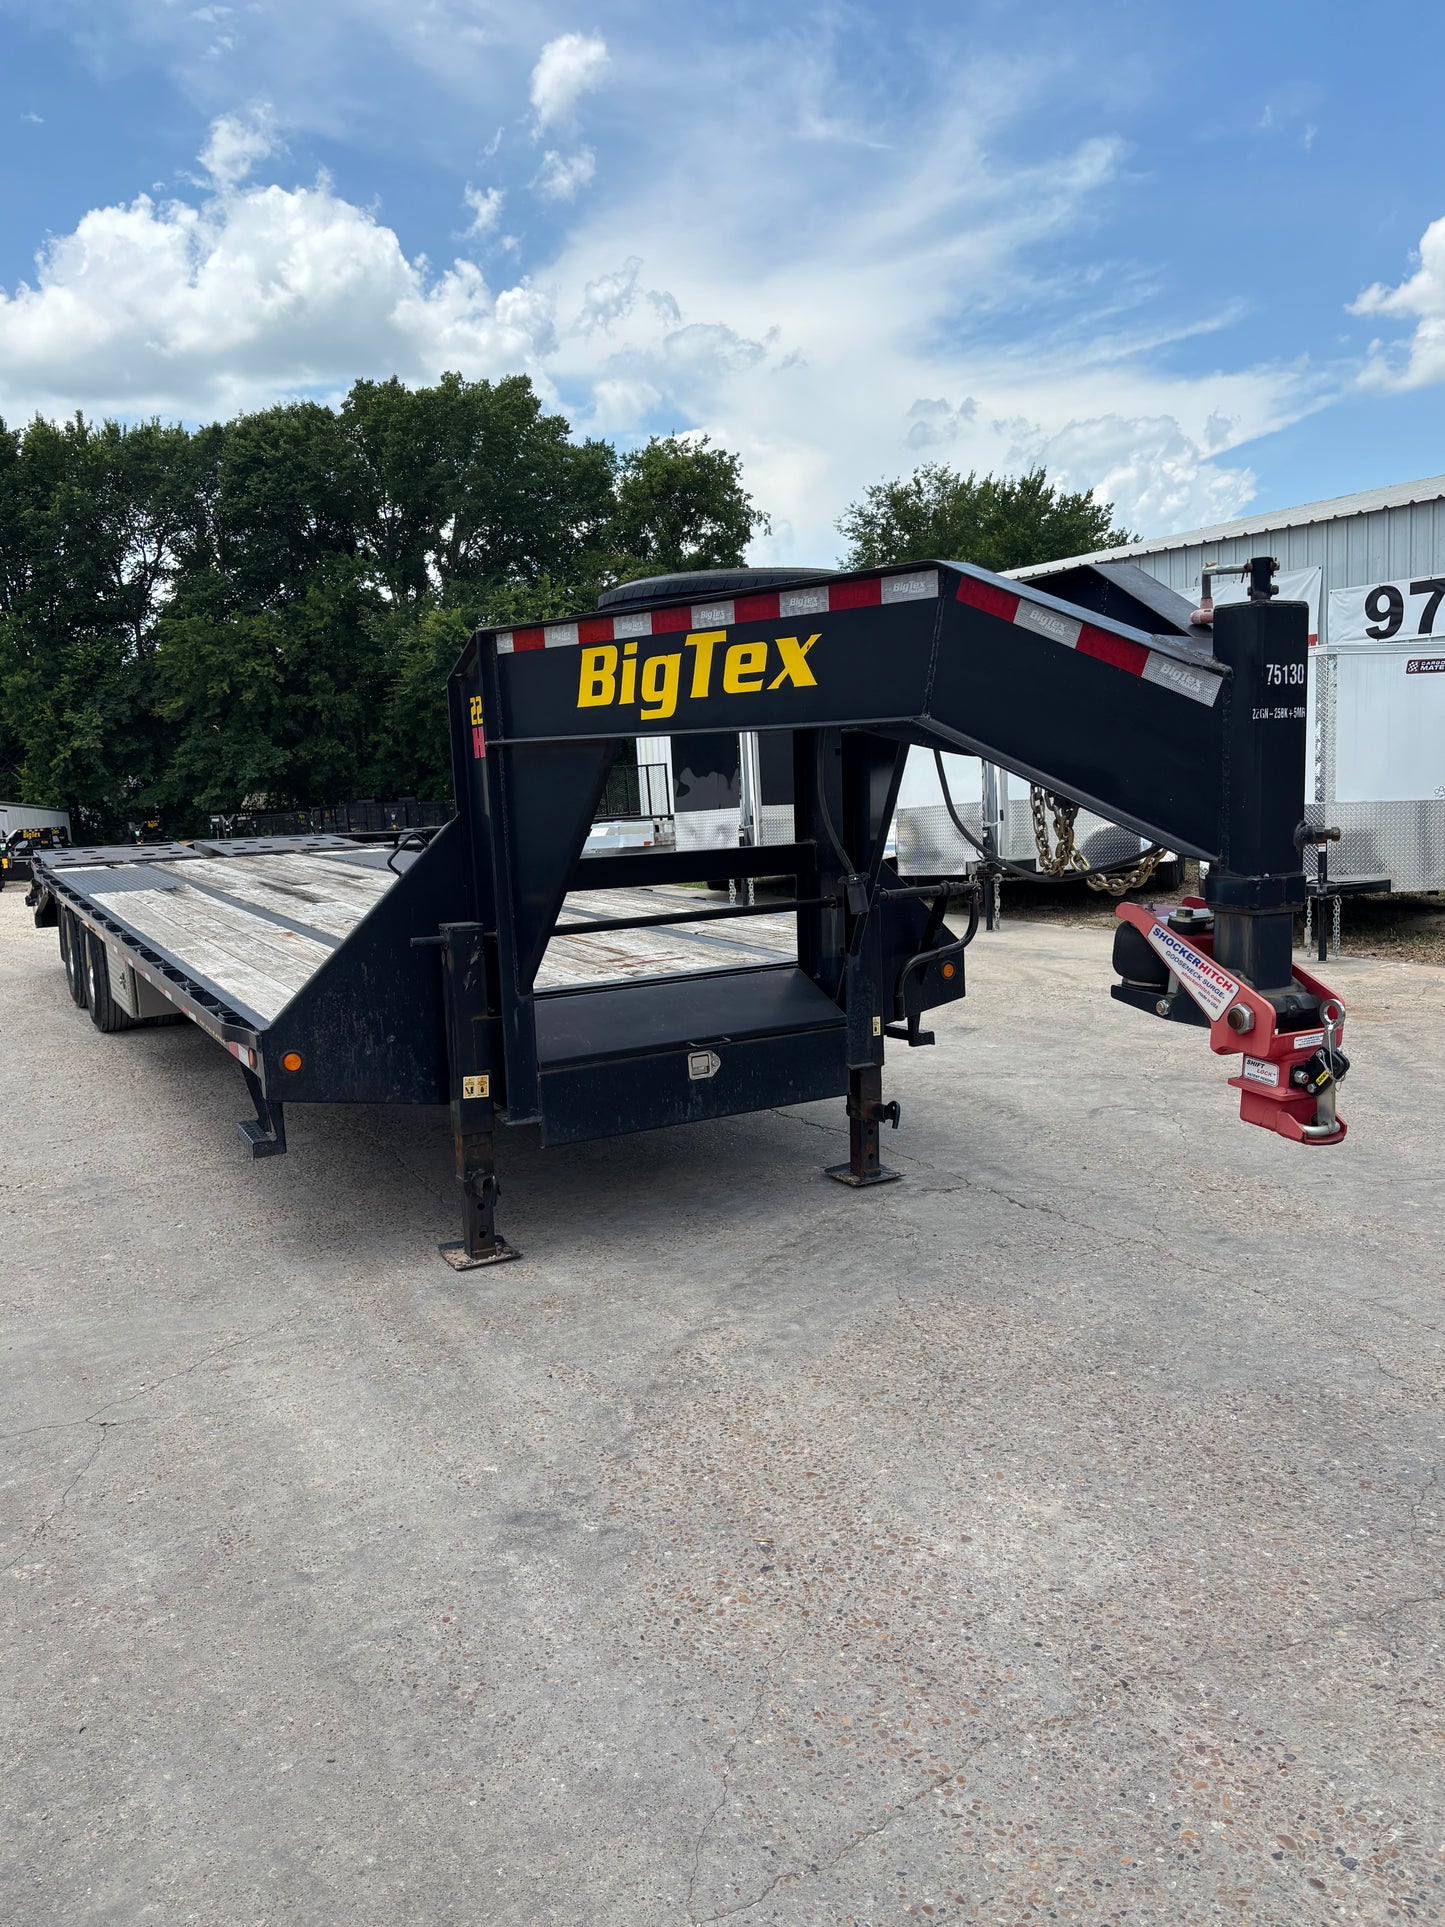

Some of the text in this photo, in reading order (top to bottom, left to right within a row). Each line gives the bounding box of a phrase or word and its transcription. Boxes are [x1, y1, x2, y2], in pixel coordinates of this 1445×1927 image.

[1365, 577, 1445, 640] 97
[576, 629, 823, 721] BigTex
[1266, 664, 1304, 685] 75130
[470, 696, 483, 725] 22
[1165, 950, 1203, 981] GOOSENECK
[1246, 1060, 1265, 1069] SHIFT
[1256, 1068, 1272, 1078] LOCK
